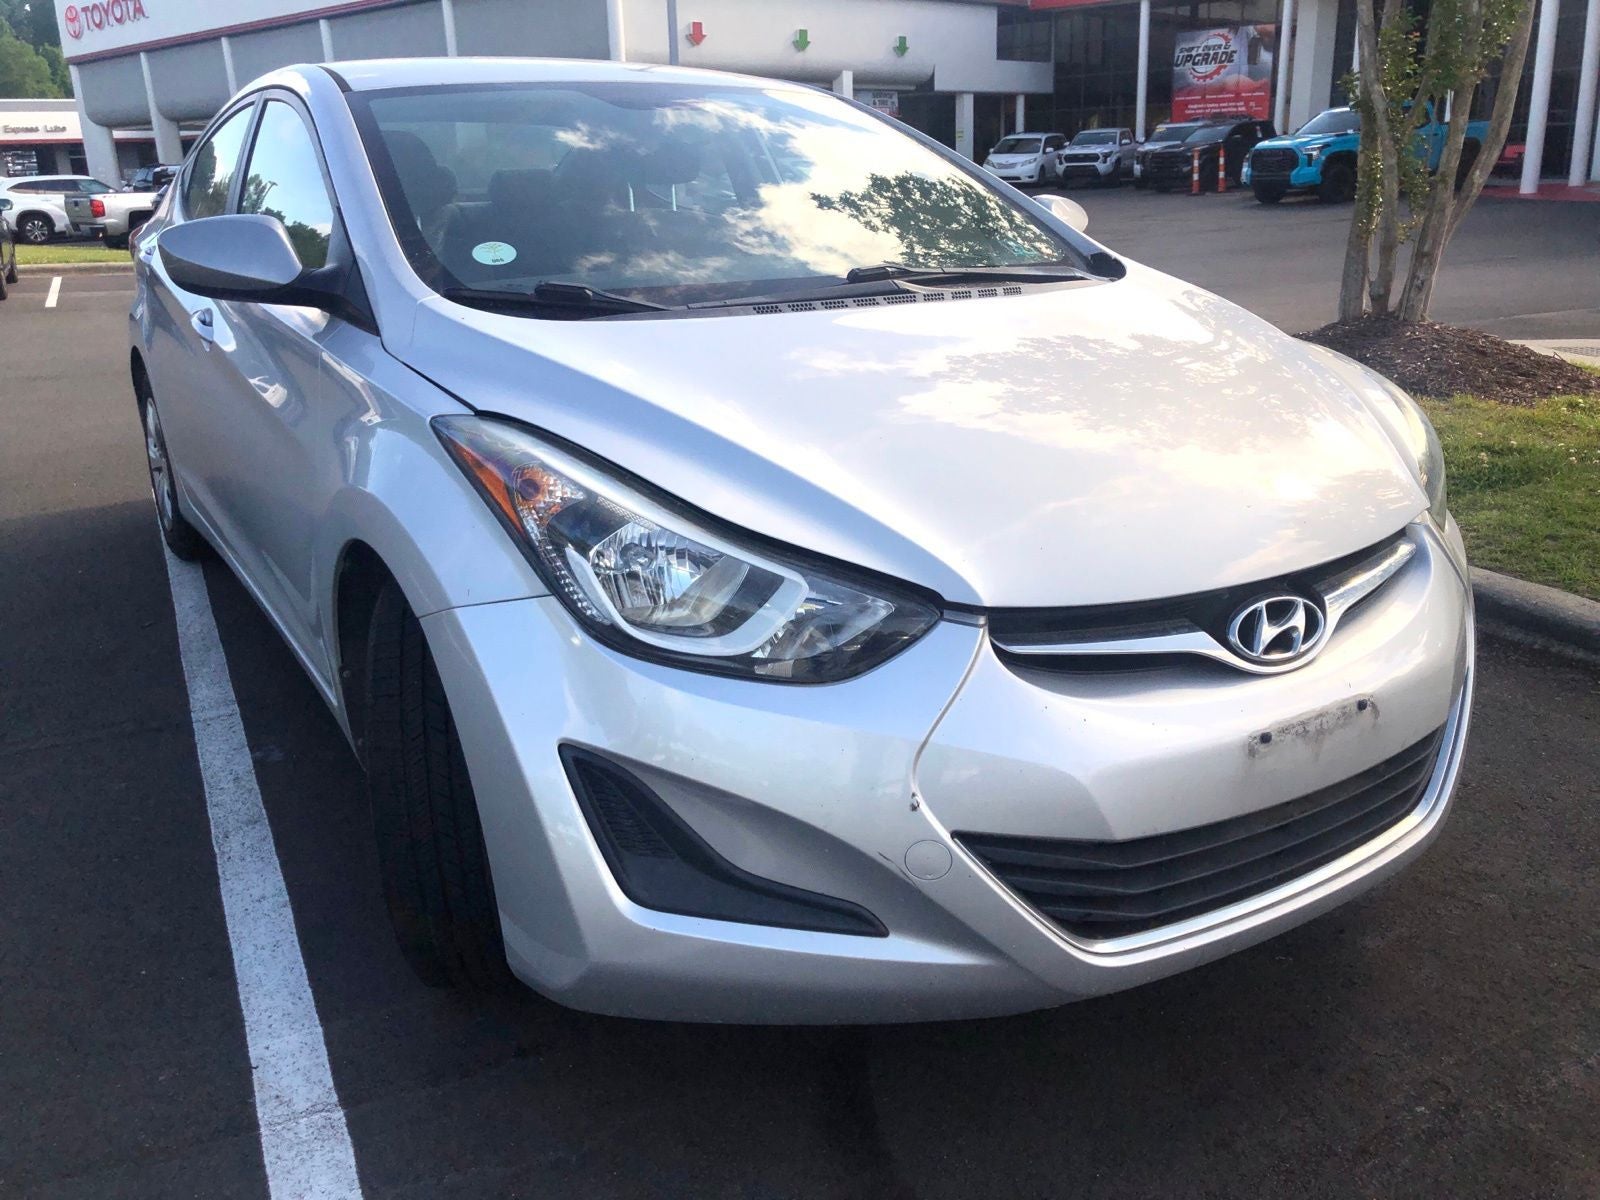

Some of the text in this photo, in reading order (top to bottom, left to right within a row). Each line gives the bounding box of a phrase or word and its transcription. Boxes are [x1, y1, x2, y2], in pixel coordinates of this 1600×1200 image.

[81, 0, 147, 30] TOYOTA
[1178, 41, 1231, 54] SHIFT OVER &
[1174, 50, 1237, 68] UPGRADE
[3, 125, 40, 134] Express
